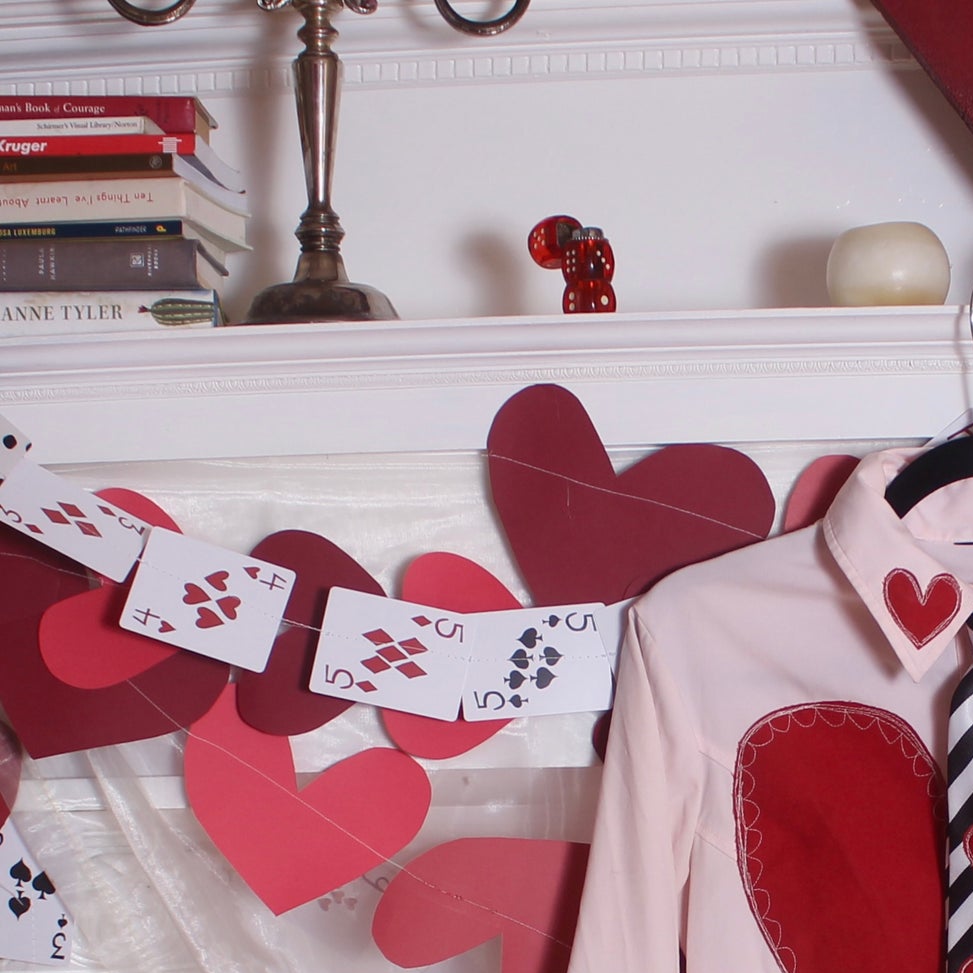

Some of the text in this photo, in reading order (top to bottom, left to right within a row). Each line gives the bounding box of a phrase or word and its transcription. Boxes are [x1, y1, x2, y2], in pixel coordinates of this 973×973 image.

[25, 103, 51, 113] Book
[63, 102, 105, 115] Courage
[36, 196, 68, 206] Learnt
[75, 195, 92, 205] I've
[97, 191, 130, 203] Things
[134, 192, 154, 202] Ten
[13, 227, 56, 237] LUXEMBURG
[2, 304, 123, 321] ANNE TYLER
[259, 573, 287, 591] 4
[132, 608, 160, 626] 4
[565, 612, 597, 632] 5
[434, 617, 464, 643] 5
[325, 664, 354, 690] 5
[473, 690, 506, 711] 5
[50, 932, 67, 960] 3
